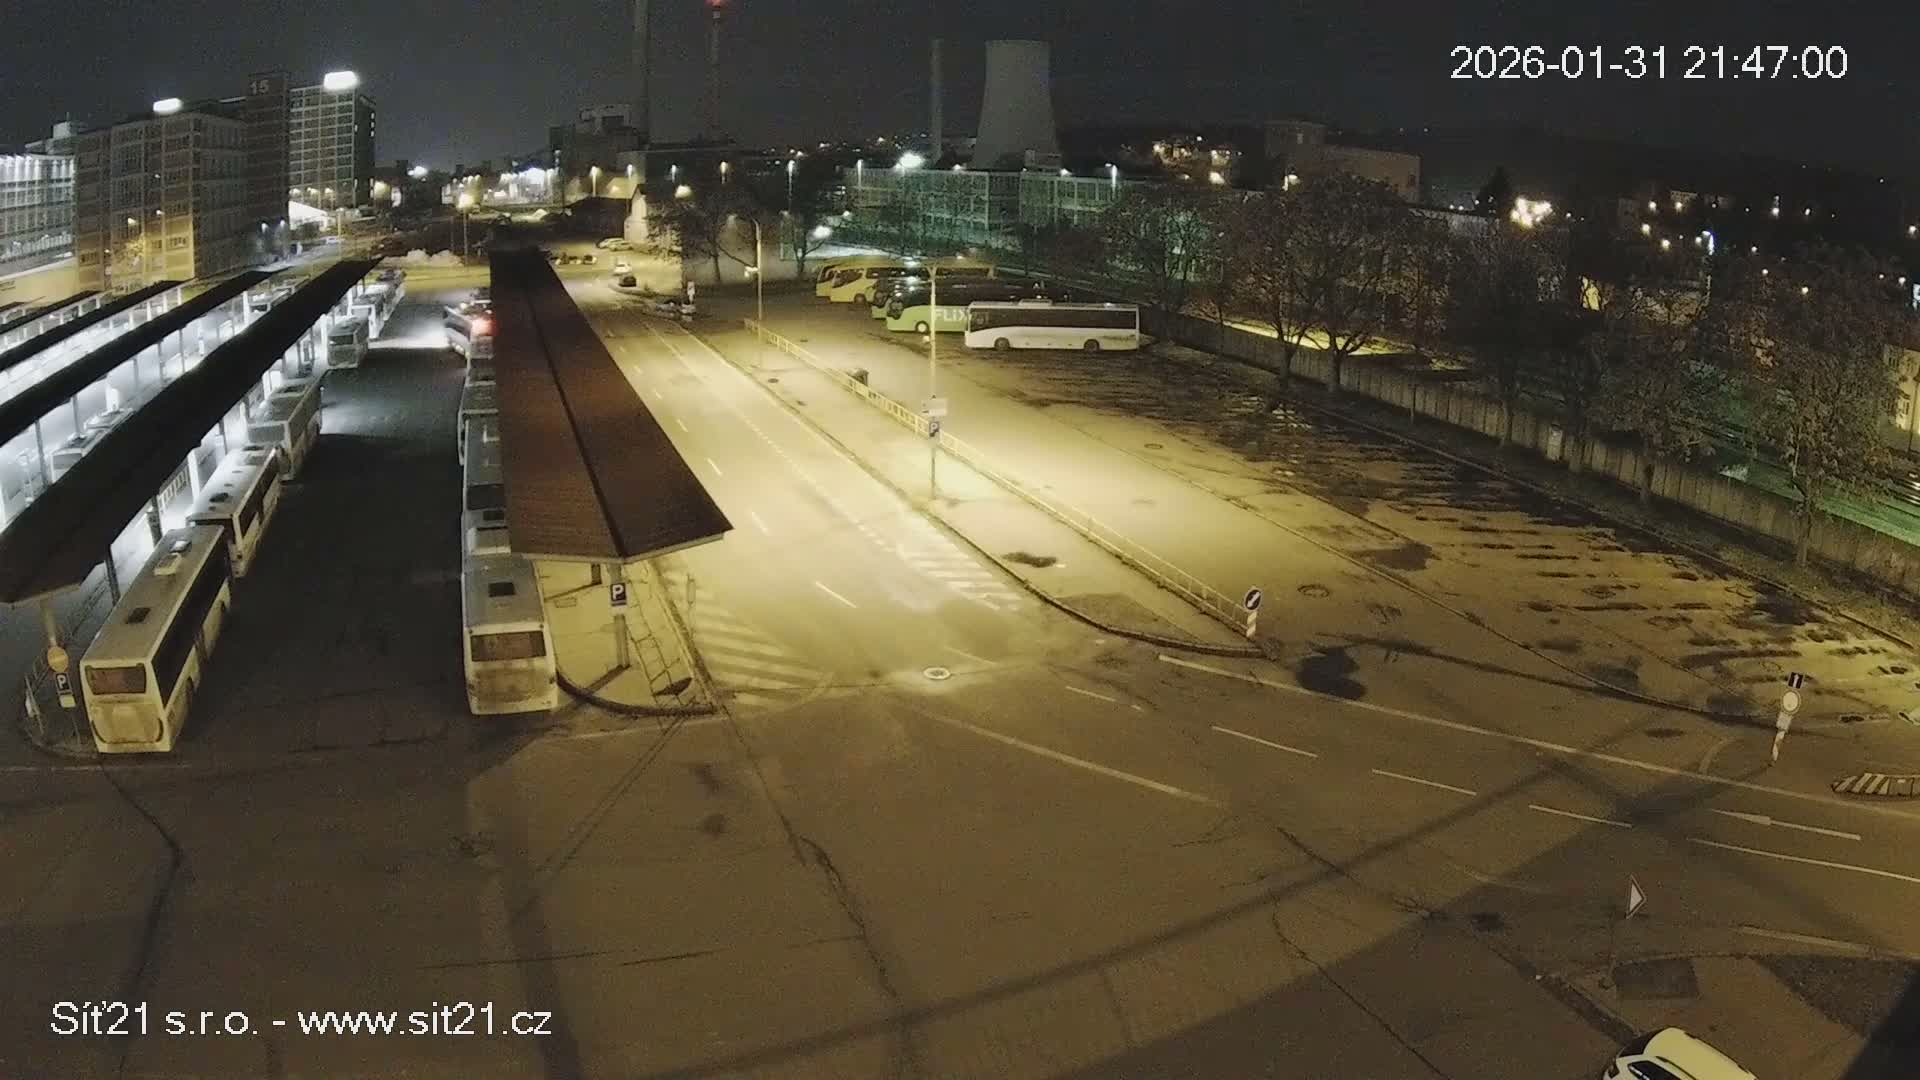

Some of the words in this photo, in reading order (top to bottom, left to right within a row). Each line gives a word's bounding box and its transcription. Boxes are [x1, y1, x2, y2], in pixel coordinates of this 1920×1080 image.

[249, 80, 270, 95] 15
[612, 584, 624, 600] P
[56, 674, 67, 689] P
